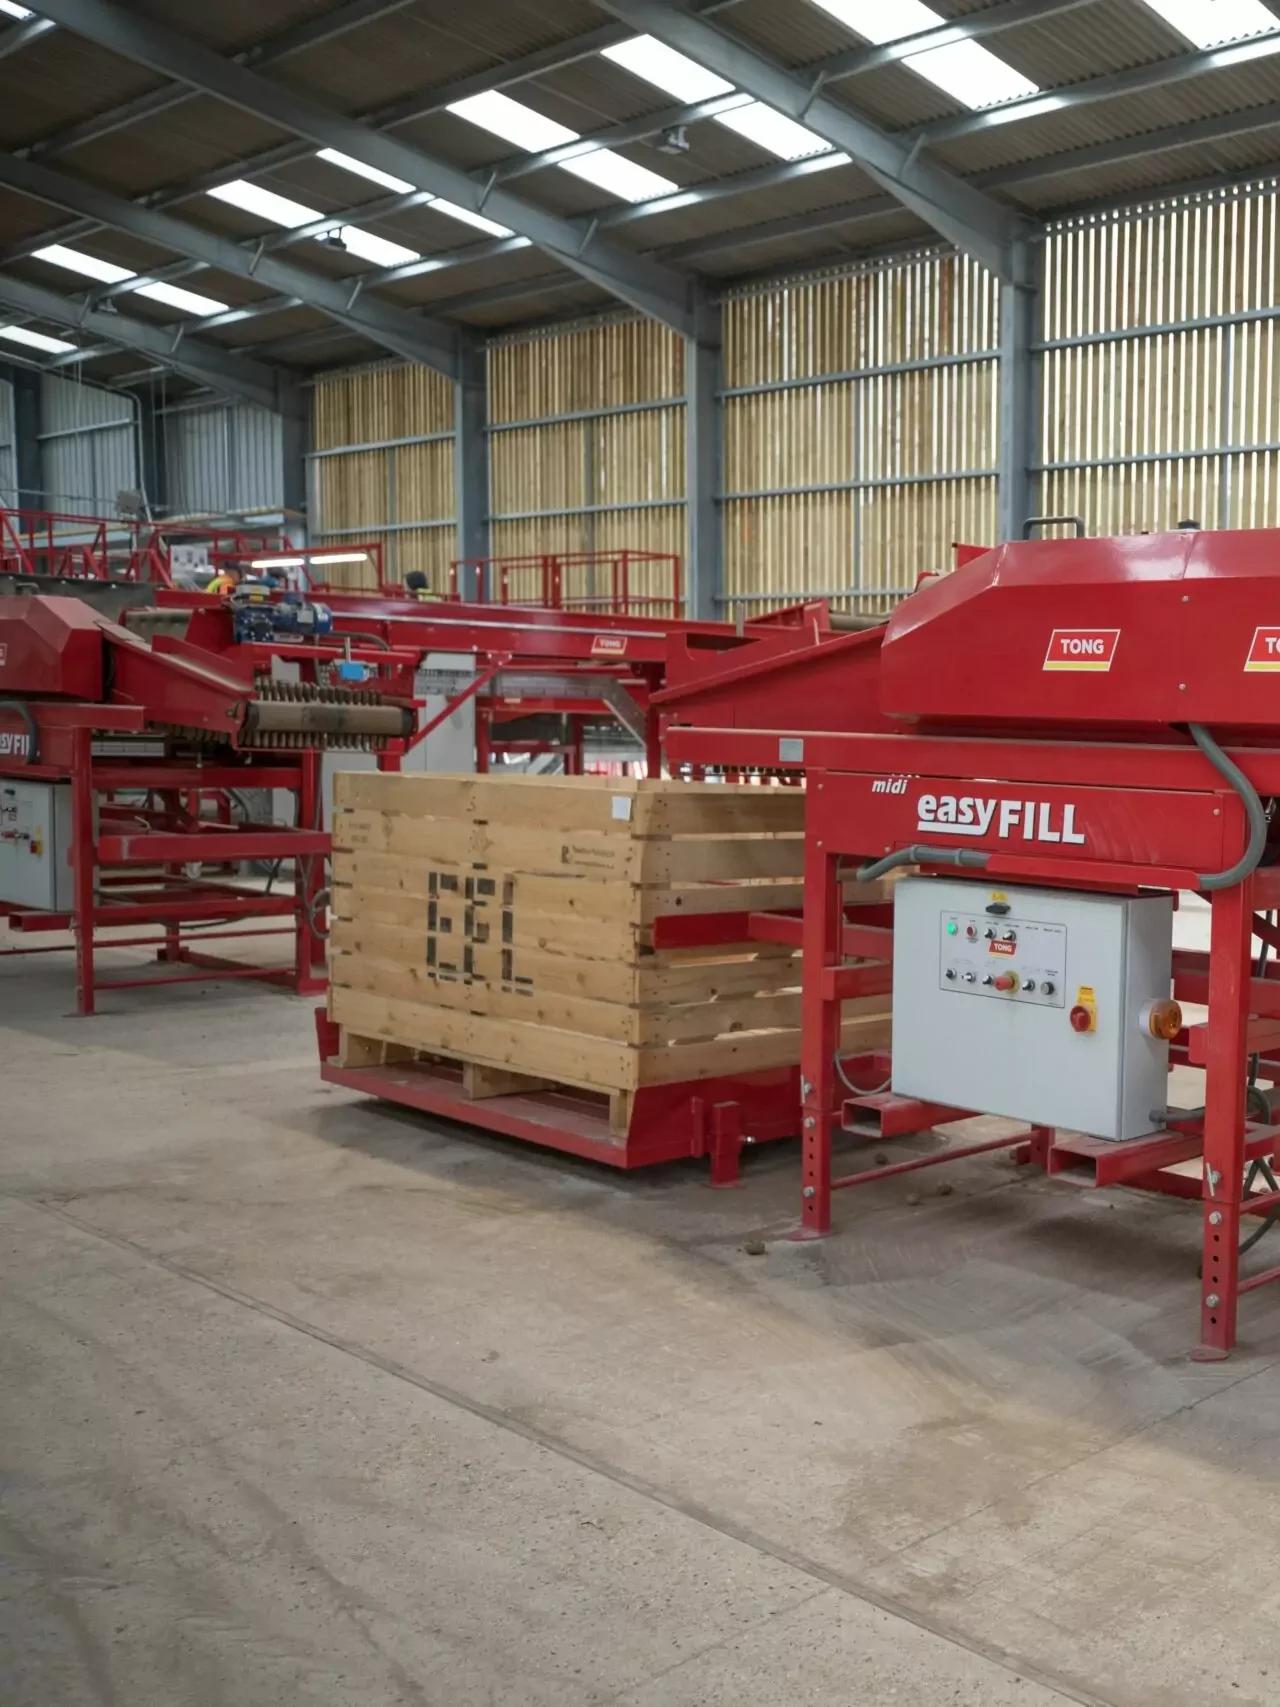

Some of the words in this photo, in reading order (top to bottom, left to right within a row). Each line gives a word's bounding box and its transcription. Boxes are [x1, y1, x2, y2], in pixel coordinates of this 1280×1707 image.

[1060, 638, 1105, 655] TONG
[872, 778, 907, 795] midi
[993, 942, 1013, 953] TONG
